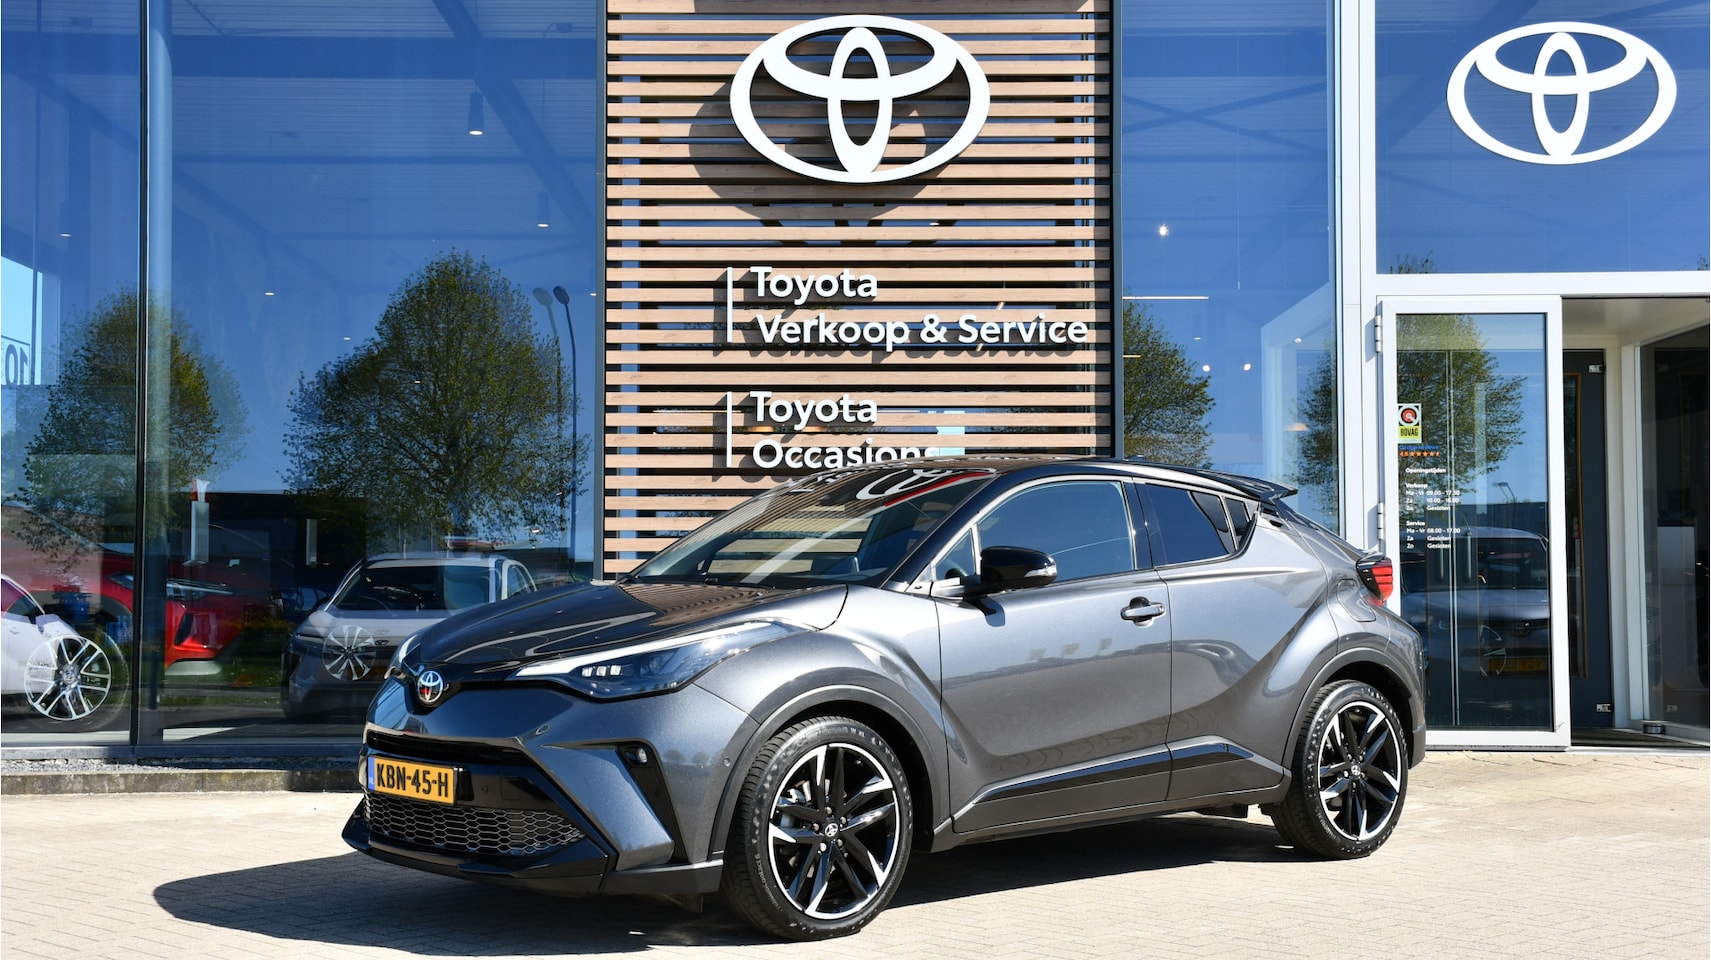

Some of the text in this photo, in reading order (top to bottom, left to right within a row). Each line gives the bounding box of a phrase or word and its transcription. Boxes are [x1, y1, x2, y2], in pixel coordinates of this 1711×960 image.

[750, 266, 878, 305] Toyota
[756, 313, 1089, 351] Verkoop & Service
[750, 391, 878, 430] Toyota
[1400, 427, 1419, 437] BOVAG
[376, 763, 449, 798] KBN-45-H
